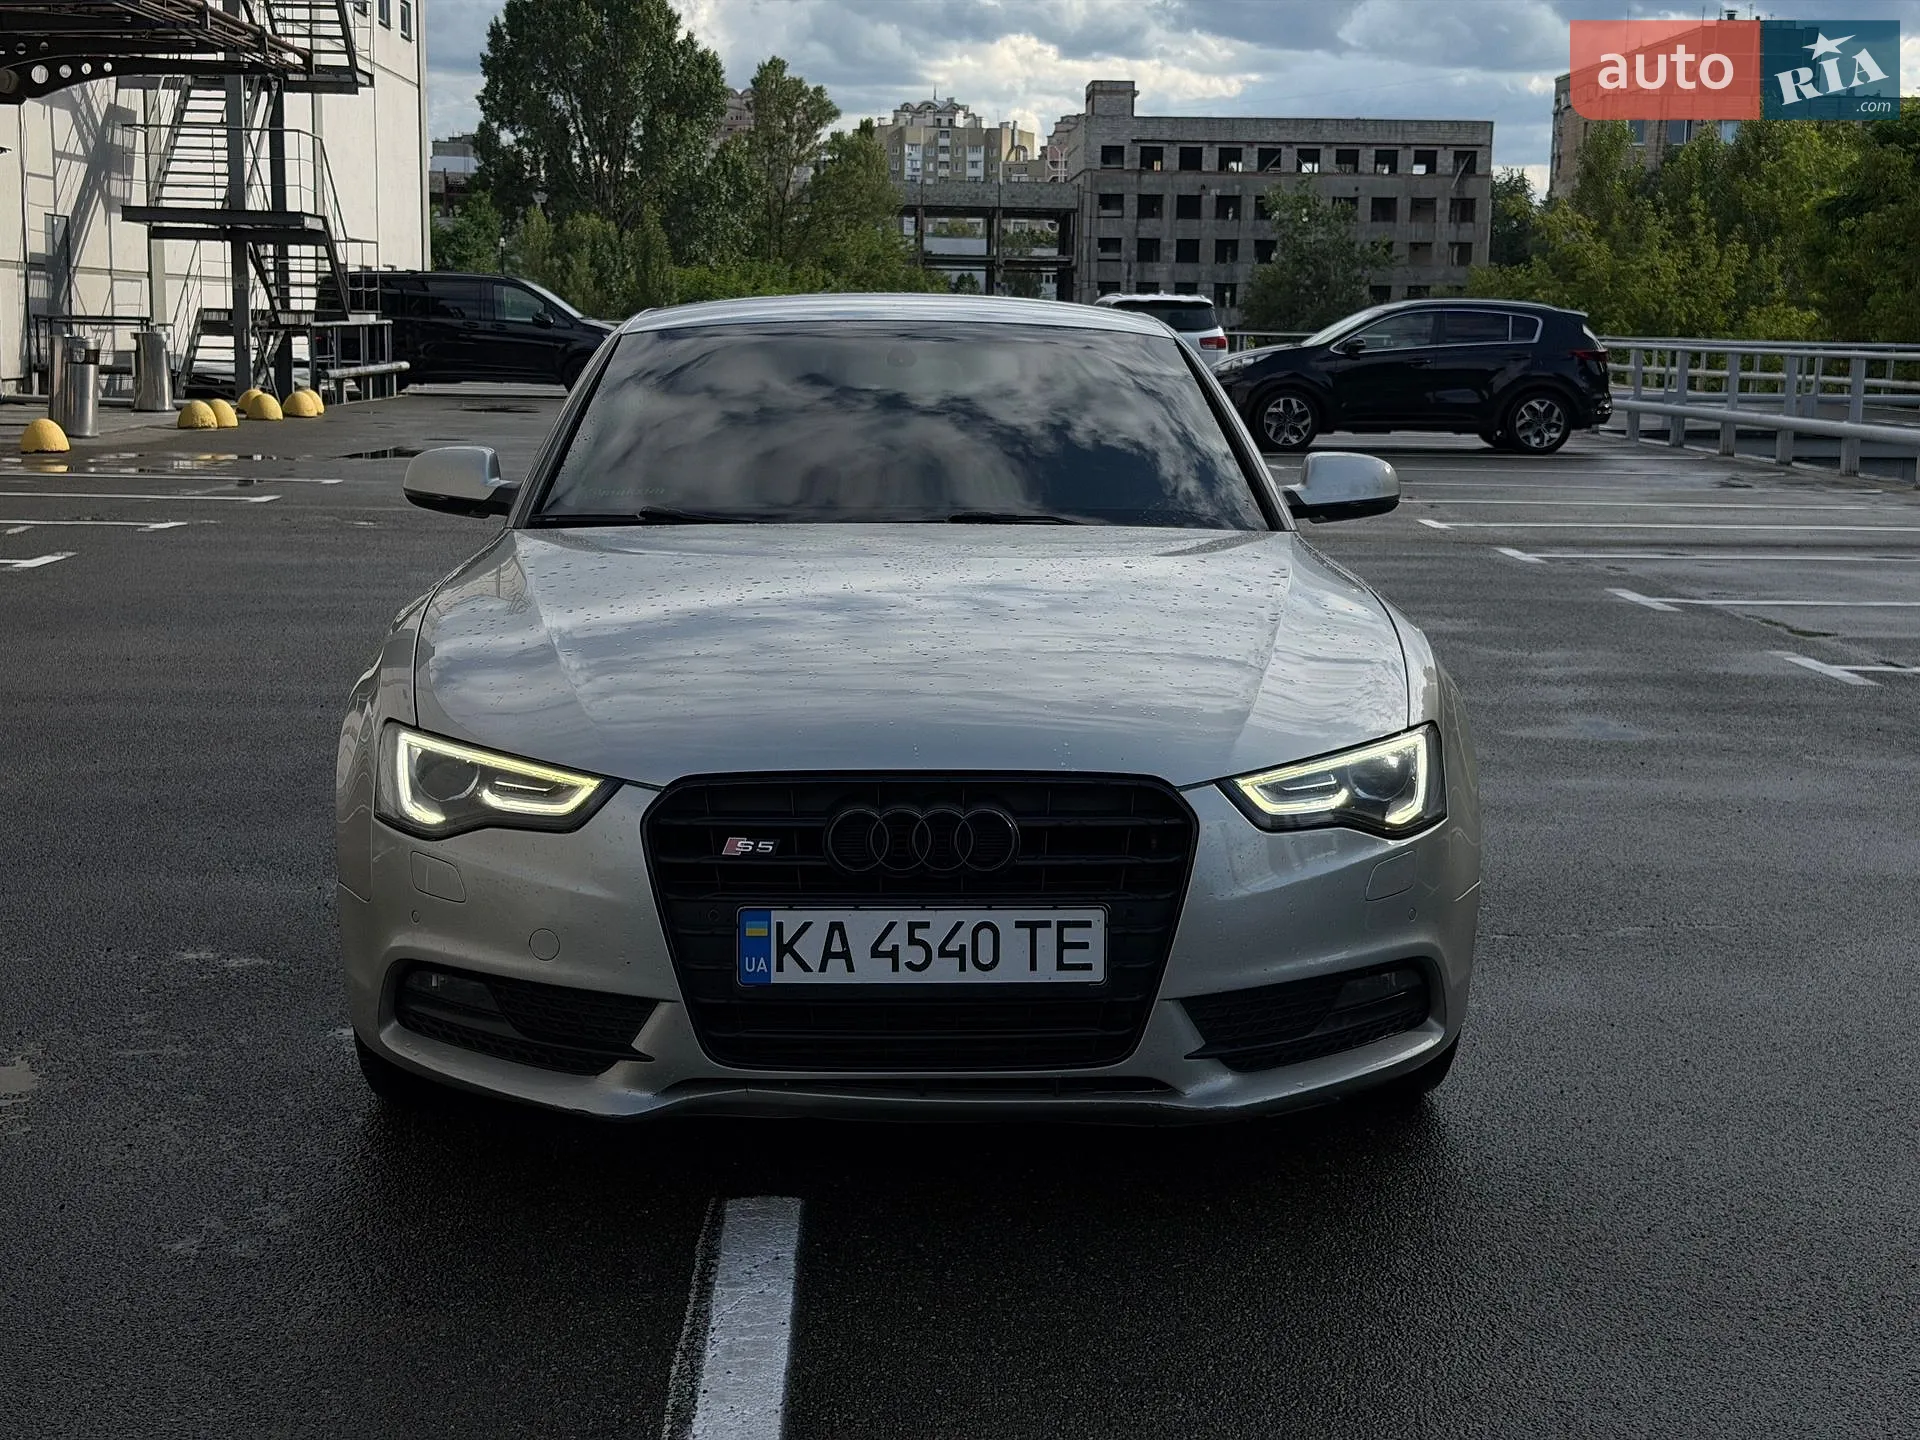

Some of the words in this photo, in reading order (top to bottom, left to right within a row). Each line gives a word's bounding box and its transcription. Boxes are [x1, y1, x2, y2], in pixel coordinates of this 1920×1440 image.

[775, 920, 856, 973] KA
[870, 920, 1000, 973] 4540
[1014, 920, 1093, 972] TE
[745, 957, 768, 973] UA
